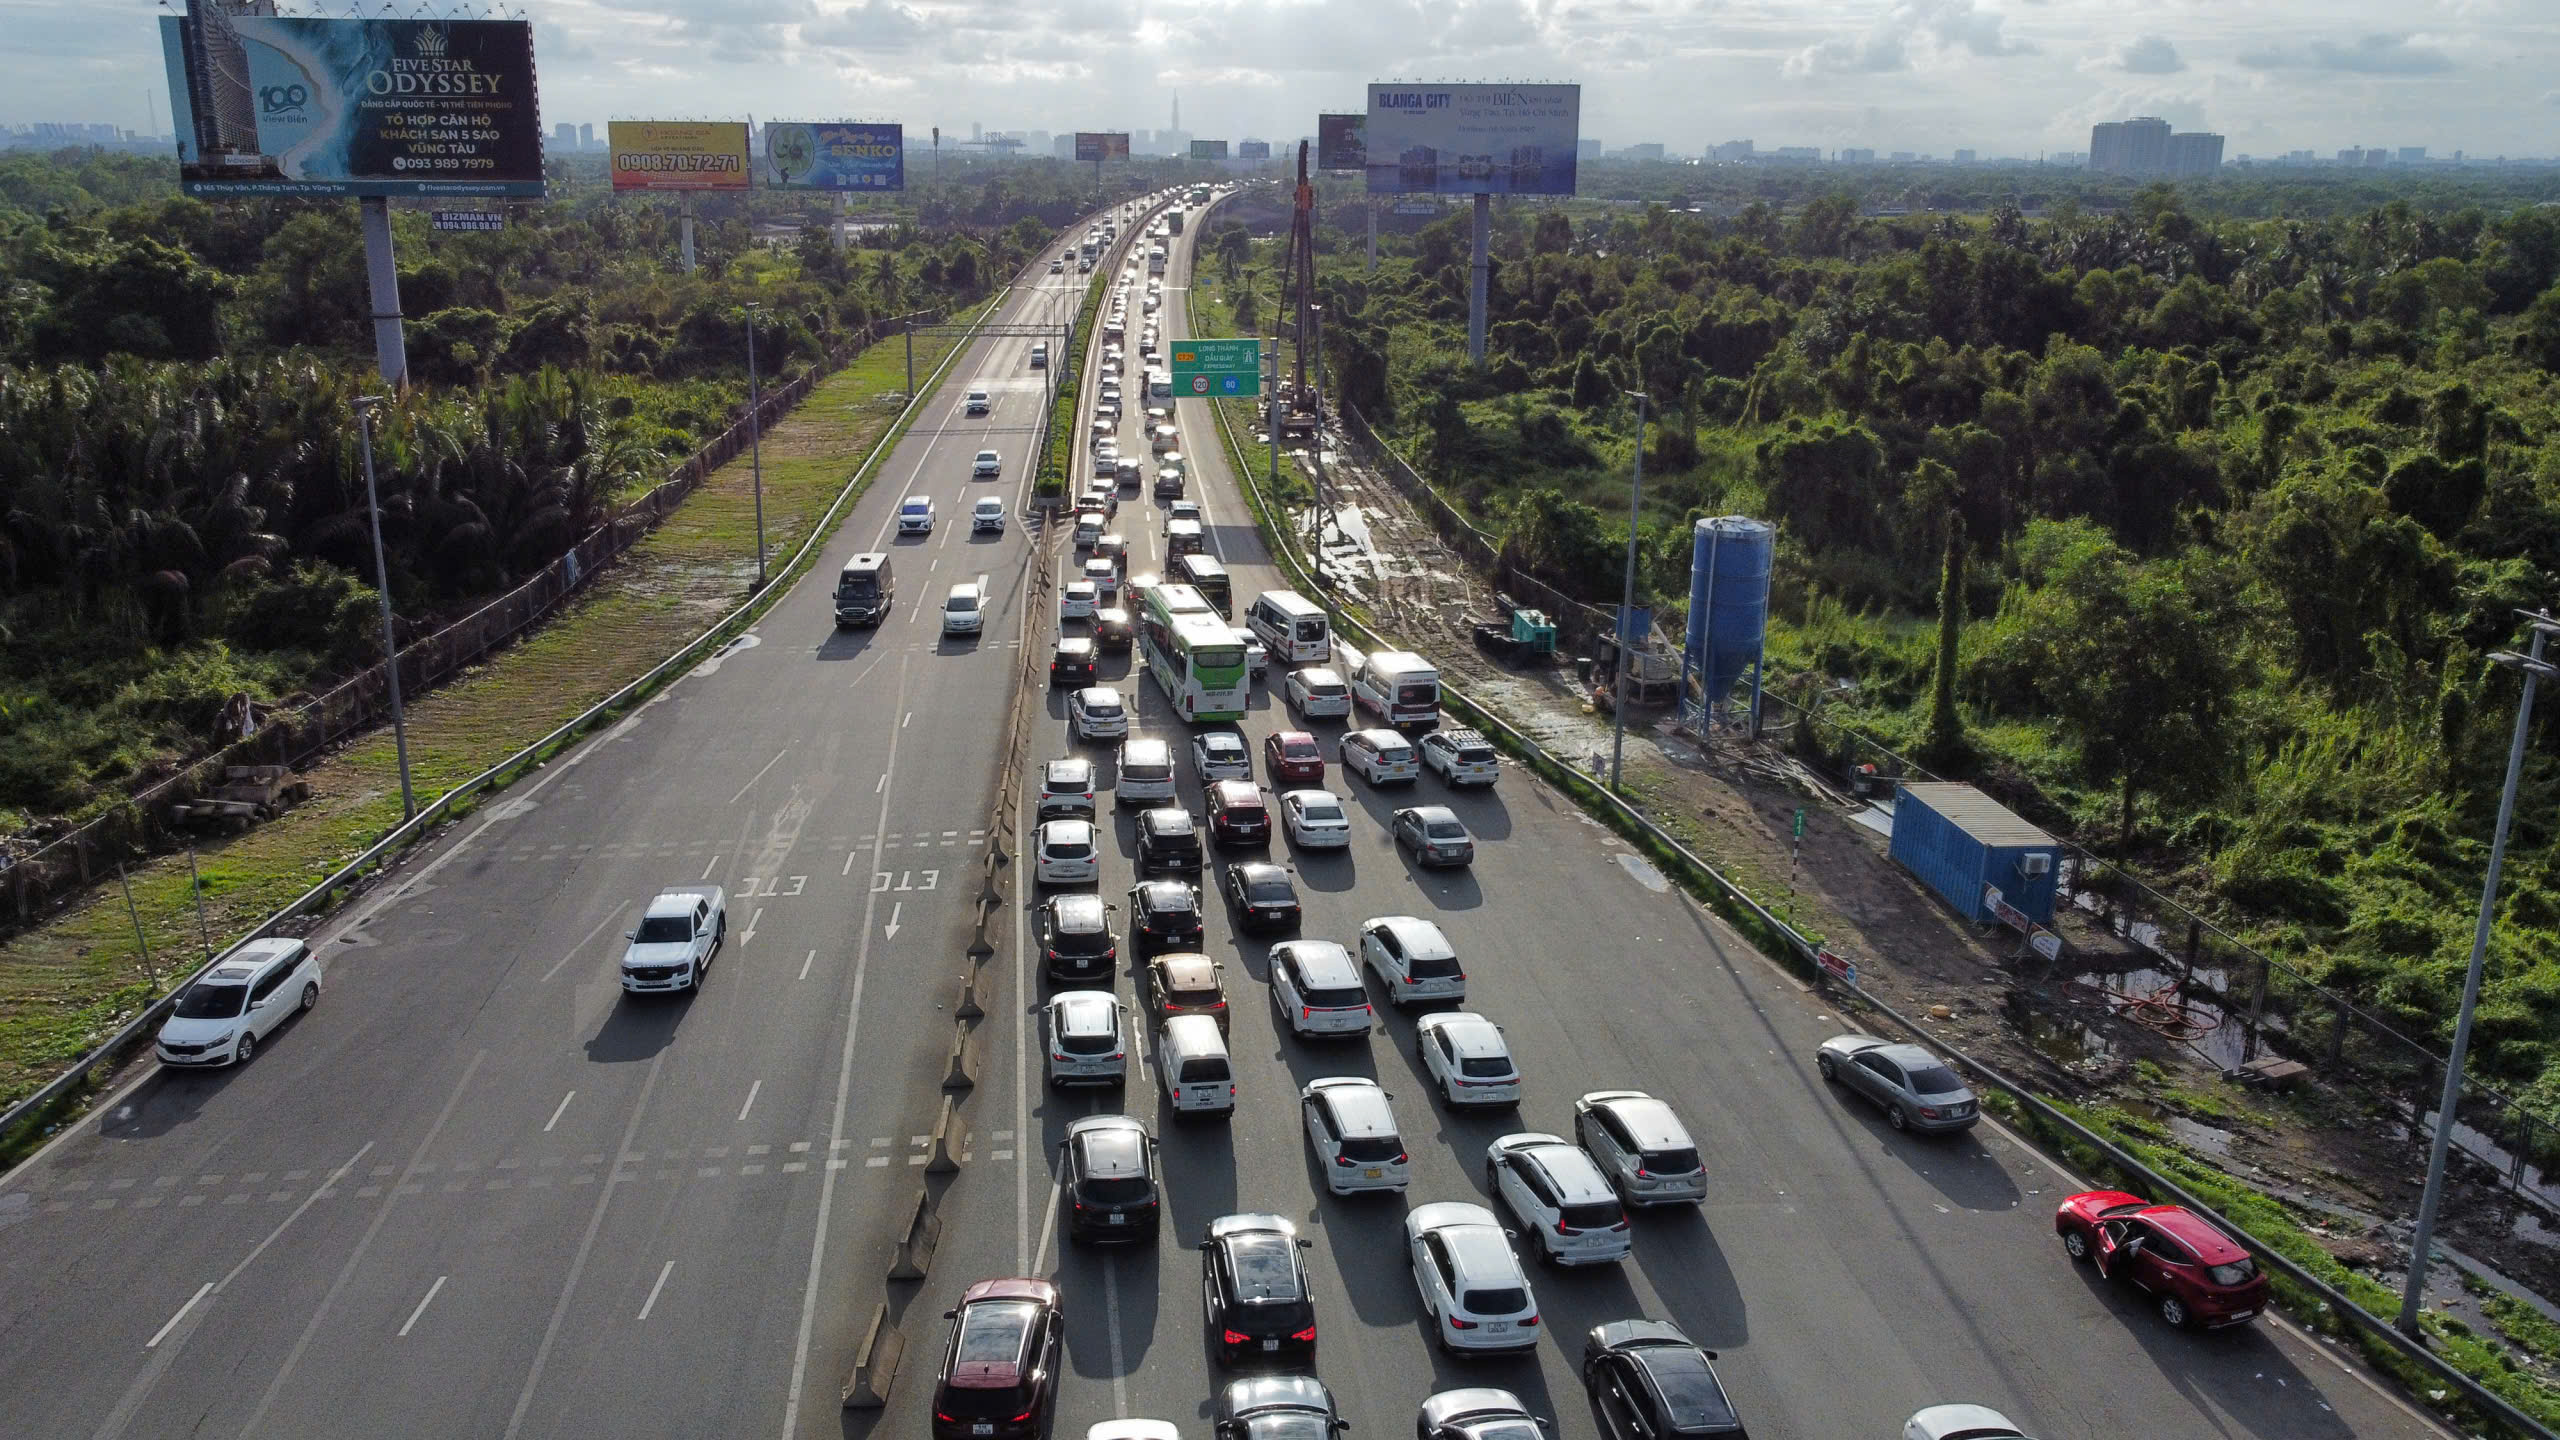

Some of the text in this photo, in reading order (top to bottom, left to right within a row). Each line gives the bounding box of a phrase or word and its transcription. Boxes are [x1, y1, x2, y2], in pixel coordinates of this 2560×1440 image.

[391, 58, 474, 73] FIVE STAR
[367, 70, 503, 95] ODYSSEY
[1425, 93, 1452, 108] CITY
[263, 114, 286, 123] View
[385, 111, 491, 128] TỔ HỢP CĂN HỘ
[380, 128, 500, 142] KHÁCH SẠN 5 SAO
[408, 142, 476, 154] VŨNG TÀU
[832, 144, 897, 158] SENKO
[407, 158, 495, 169] 093 989 7979
[618, 154, 739, 172] 0908.70.72.71
[441, 213, 502, 222] BIZMAN.VN
[1195, 381, 1207, 389] 120
[1225, 381, 1236, 389] 60
[734, 875, 808, 898] ETC
[870, 869, 940, 893] ETC
